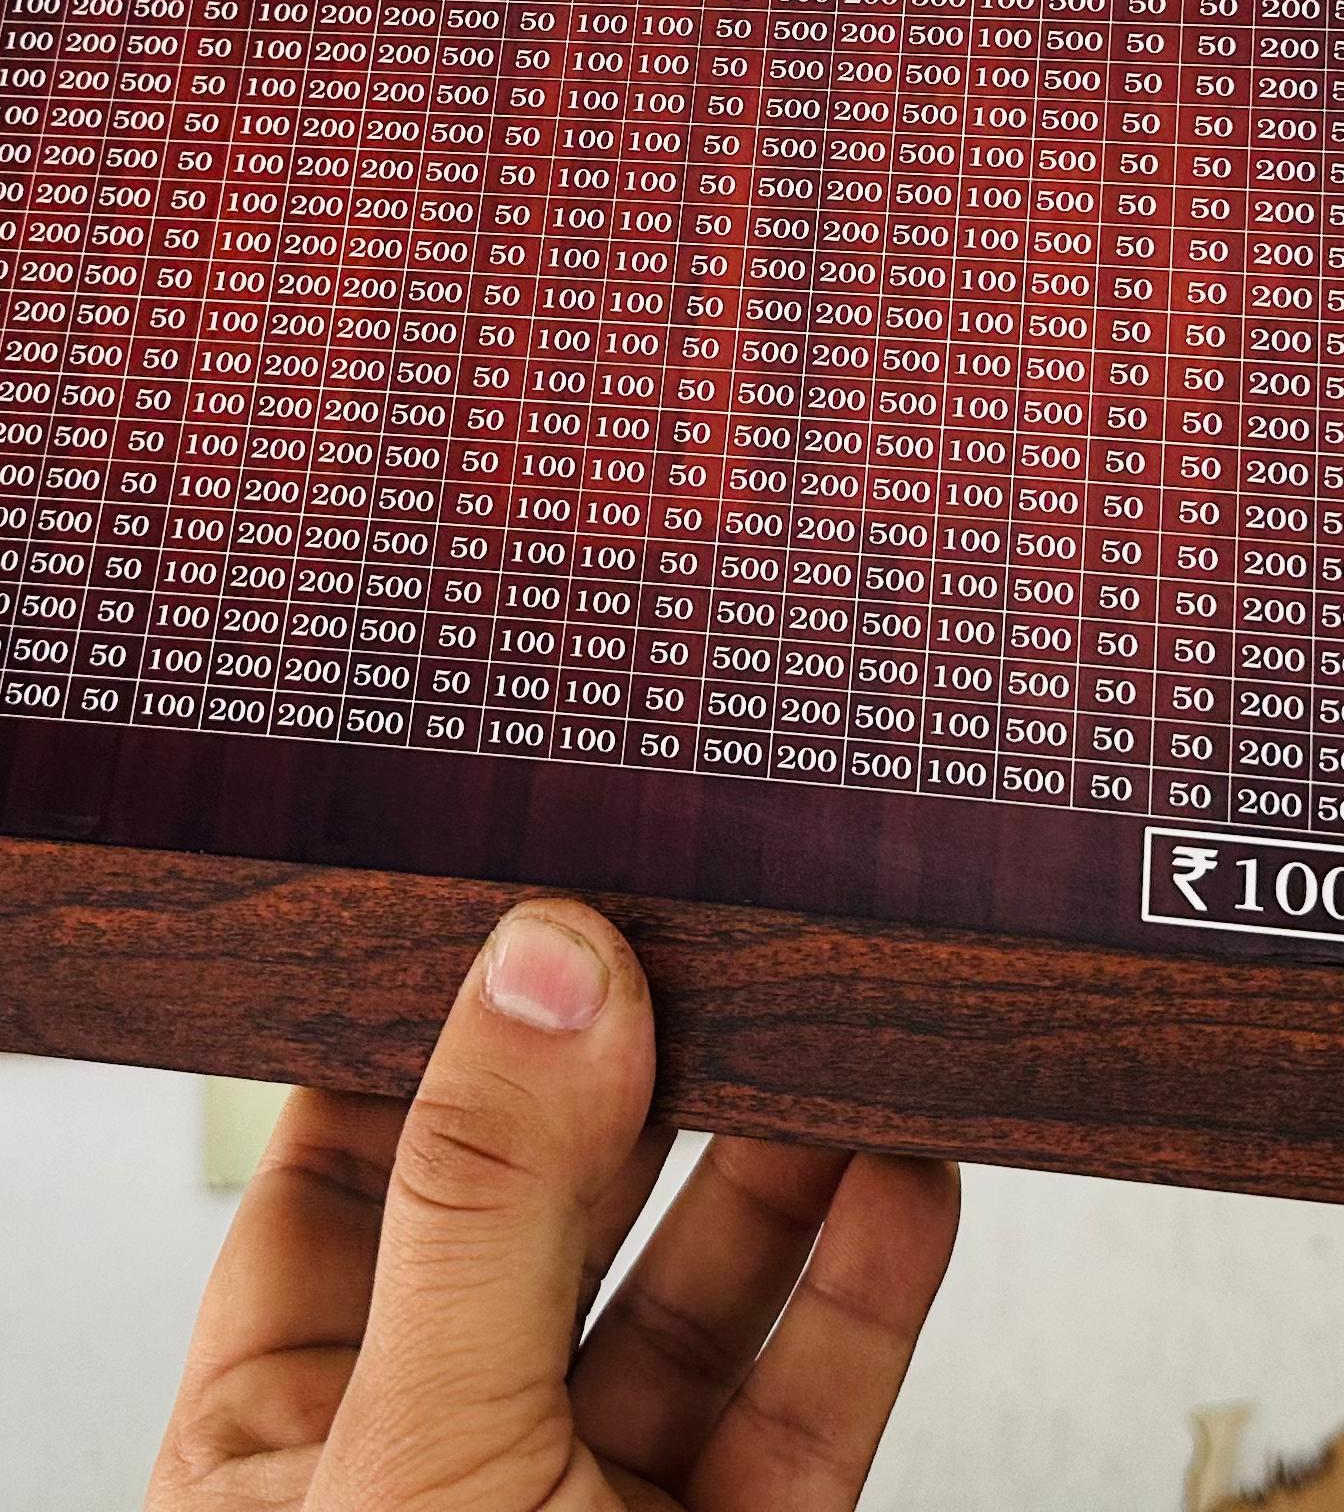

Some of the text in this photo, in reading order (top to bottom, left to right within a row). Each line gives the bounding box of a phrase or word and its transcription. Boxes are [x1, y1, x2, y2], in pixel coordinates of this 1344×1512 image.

[57, 69, 110, 91] 200
[119, 72, 172, 93] 500
[190, 75, 226, 95] 50
[246, 77, 297, 98] 100
[308, 79, 361, 100] 200
[371, 82, 425, 103] 200
[436, 84, 489, 106] 500
[509, 87, 546, 108] 50
[567, 90, 619, 111] 100
[633, 93, 685, 114] 100
[707, 95, 744, 117] 50
[765, 98, 821, 120] 500
[833, 100, 889, 123] 200
[901, 103, 958, 126] 500
[972, 106, 1027, 129] 100
[1041, 109, 1099, 132] 500
[1121, 112, 1161, 134] 50
[1194, 115, 1234, 138] 50
[1257, 118, 1317, 141] 200
[28, 222, 81, 244] 200
[91, 225, 144, 247] 500
[163, 228, 200, 250] 50
[220, 231, 272, 253] 100
[283, 234, 338, 256] 200
[348, 237, 403, 260] 200
[414, 240, 468, 263] 500
[489, 244, 526, 266] 50
[548, 247, 600, 270] 100
[614, 251, 668, 273] 100
[690, 254, 728, 277] 50
[750, 257, 806, 281] 500
[819, 261, 876, 285] 200
[889, 265, 946, 289] 500
[960, 269, 1017, 293] 100
[1031, 272, 1090, 297] 500
[1113, 277, 1153, 301] 50
[1187, 281, 1228, 305] 50
[1251, 285, 1313, 310] 200
[61, 384, 116, 408] 500
[135, 388, 172, 411] 50
[193, 392, 245, 415] 100
[259, 395, 313, 419] 200
[323, 399, 379, 423] 200
[390, 403, 446, 427] 500
[467, 407, 505, 431] 50
[526, 412, 581, 436] 100
[595, 416, 650, 440] 100
[673, 420, 711, 444] 50
[733, 424, 791, 450] 500
[804, 429, 863, 454] 200
[875, 434, 934, 459] 500
[948, 439, 1006, 464] 100
[1020, 444, 1081, 470] 500
[1105, 450, 1146, 475] 50
[1180, 455, 1222, 480] 50
[1246, 460, 1309, 487] 200
[29, 551, 85, 576] 500
[105, 556, 142, 580] 50
[163, 560, 217, 585] 100
[229, 565, 286, 590] 200
[297, 569, 354, 595] 200
[365, 574, 423, 600] 500
[444, 580, 482, 604] 50
[505, 585, 561, 610] 100
[575, 590, 631, 615] 100
[654, 595, 694, 620] 50
[716, 600, 775, 627] 500
[788, 606, 849, 633] 200
[862, 612, 922, 639] 500
[936, 618, 996, 645] 100
[1010, 624, 1072, 652] 500
[1097, 631, 1139, 658] 50
[1174, 638, 1216, 665] 50
[1241, 644, 1306, 672] 200
[4, 682, 61, 708] 500
[81, 687, 119, 713] 50
[141, 693, 195, 718] 100
[208, 697, 265, 724] 200
[276, 703, 335, 729] 200
[346, 708, 404, 735] 500
[426, 714, 465, 740] 50
[488, 720, 544, 747] 100
[559, 726, 616, 753] 100
[640, 733, 680, 759] 50
[703, 738, 763, 766] 500
[776, 745, 837, 773] 200
[850, 751, 912, 780] 500
[927, 759, 987, 787] 100
[1002, 765, 1065, 795] 500
[1090, 774, 1133, 801] 50
[1168, 781, 1212, 809] 50
[1237, 788, 1303, 818] 200
